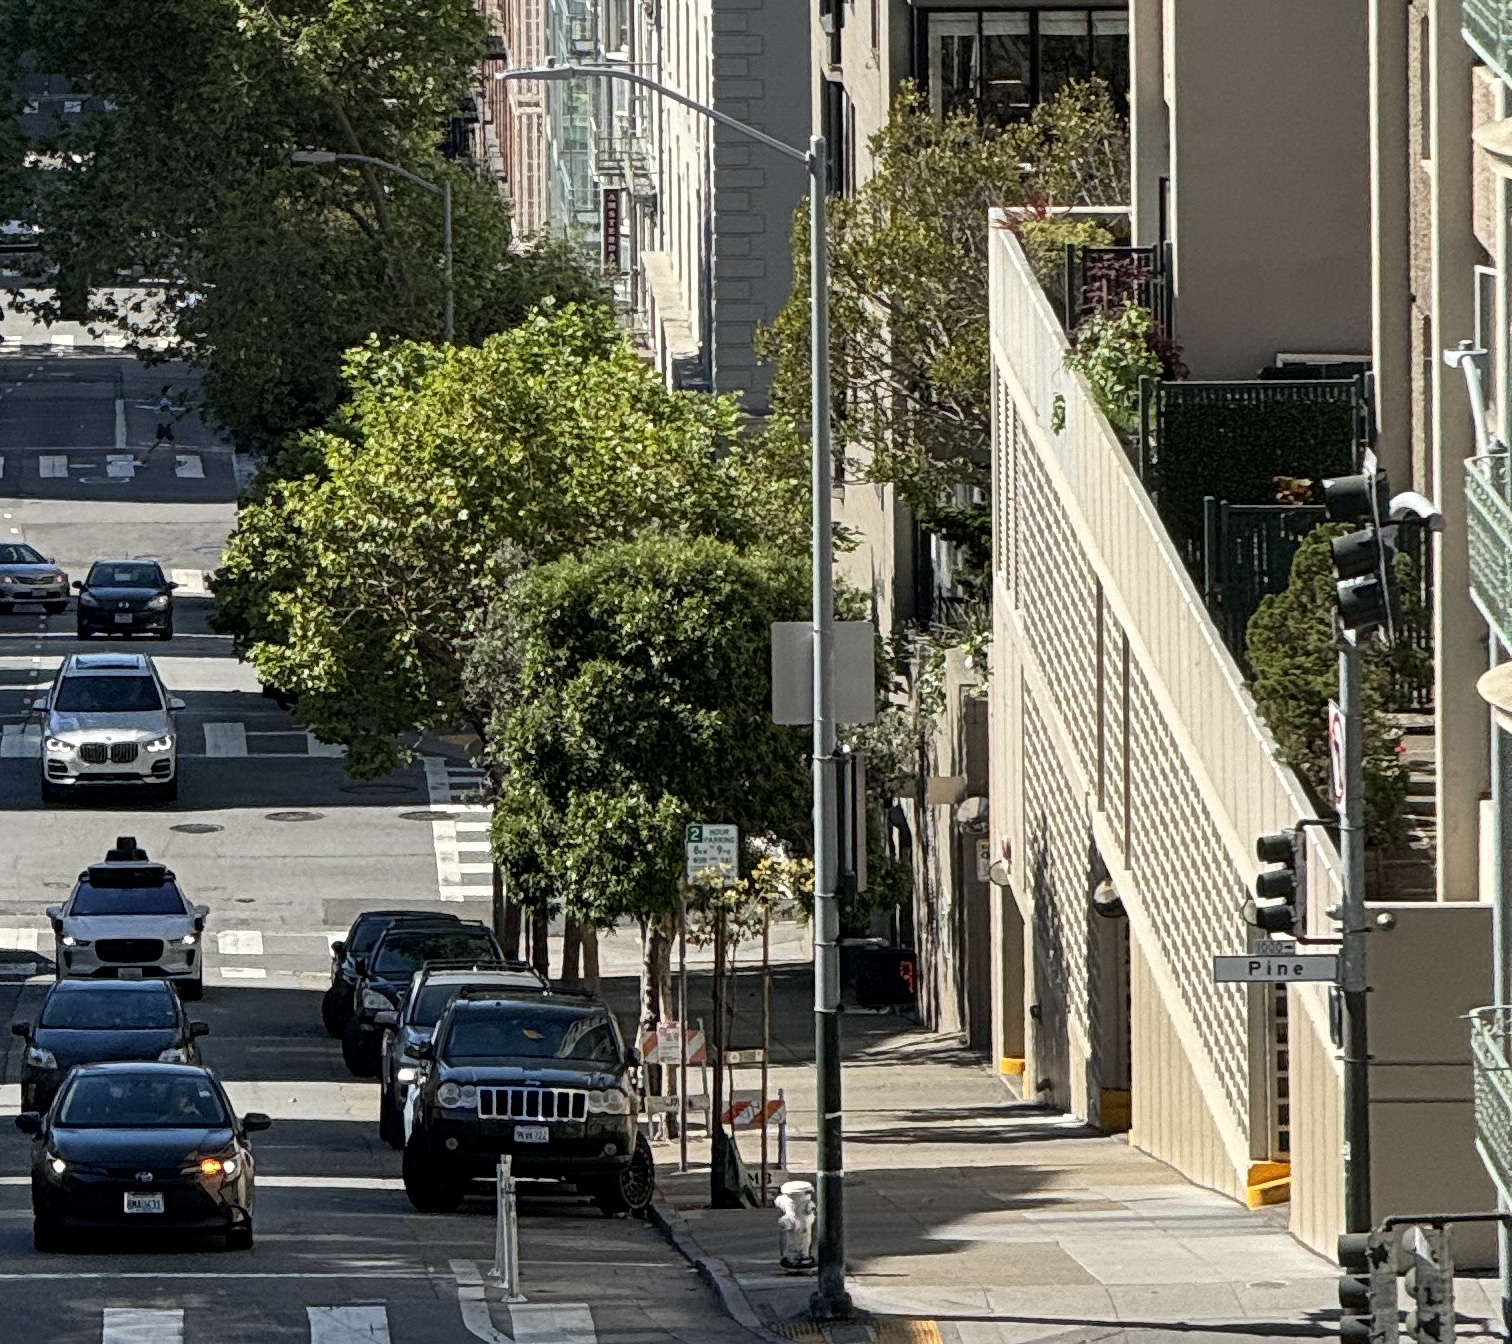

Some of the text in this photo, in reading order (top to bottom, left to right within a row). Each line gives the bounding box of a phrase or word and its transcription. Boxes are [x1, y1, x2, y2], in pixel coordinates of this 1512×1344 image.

[607, 193, 617, 262] AMSTERDA
[690, 828, 701, 841] 2
[1248, 960, 1304, 976] Pine
